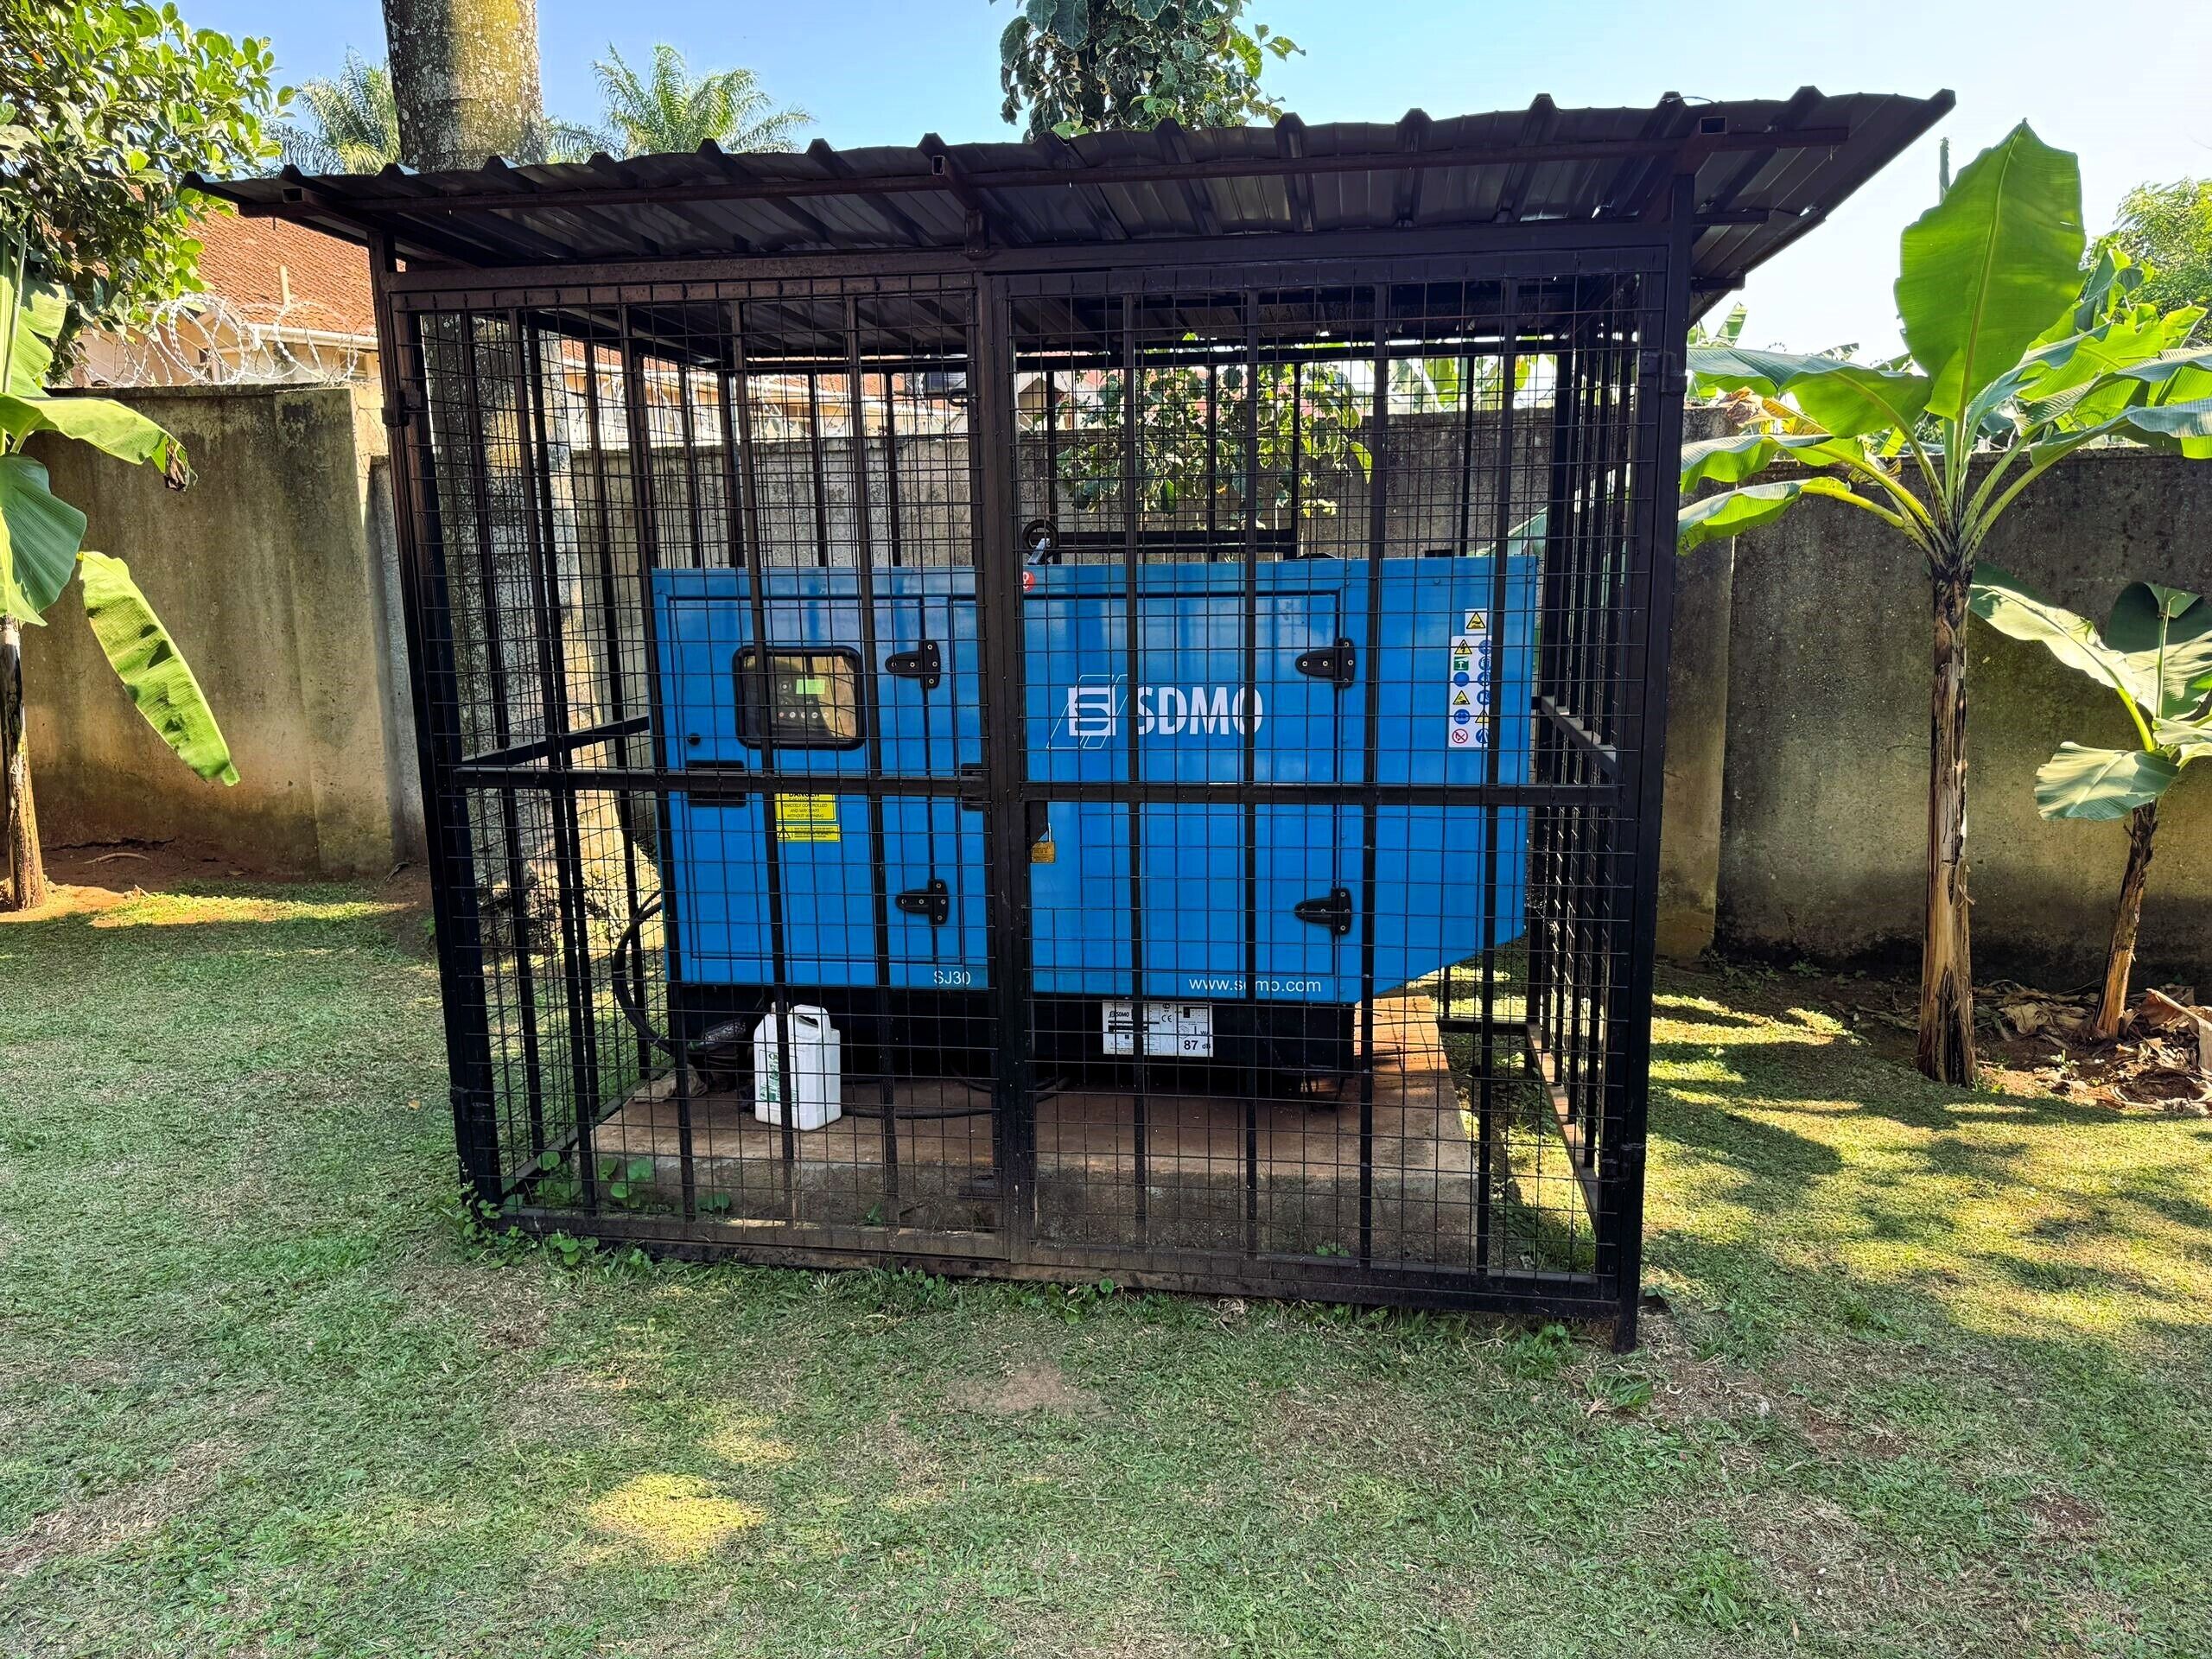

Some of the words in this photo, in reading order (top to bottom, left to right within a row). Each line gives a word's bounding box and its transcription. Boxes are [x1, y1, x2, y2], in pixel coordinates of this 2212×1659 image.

[1136, 686, 1263, 734] SDMO
[934, 970, 971, 984] SJ30
[1184, 1039, 1198, 1050] 87
